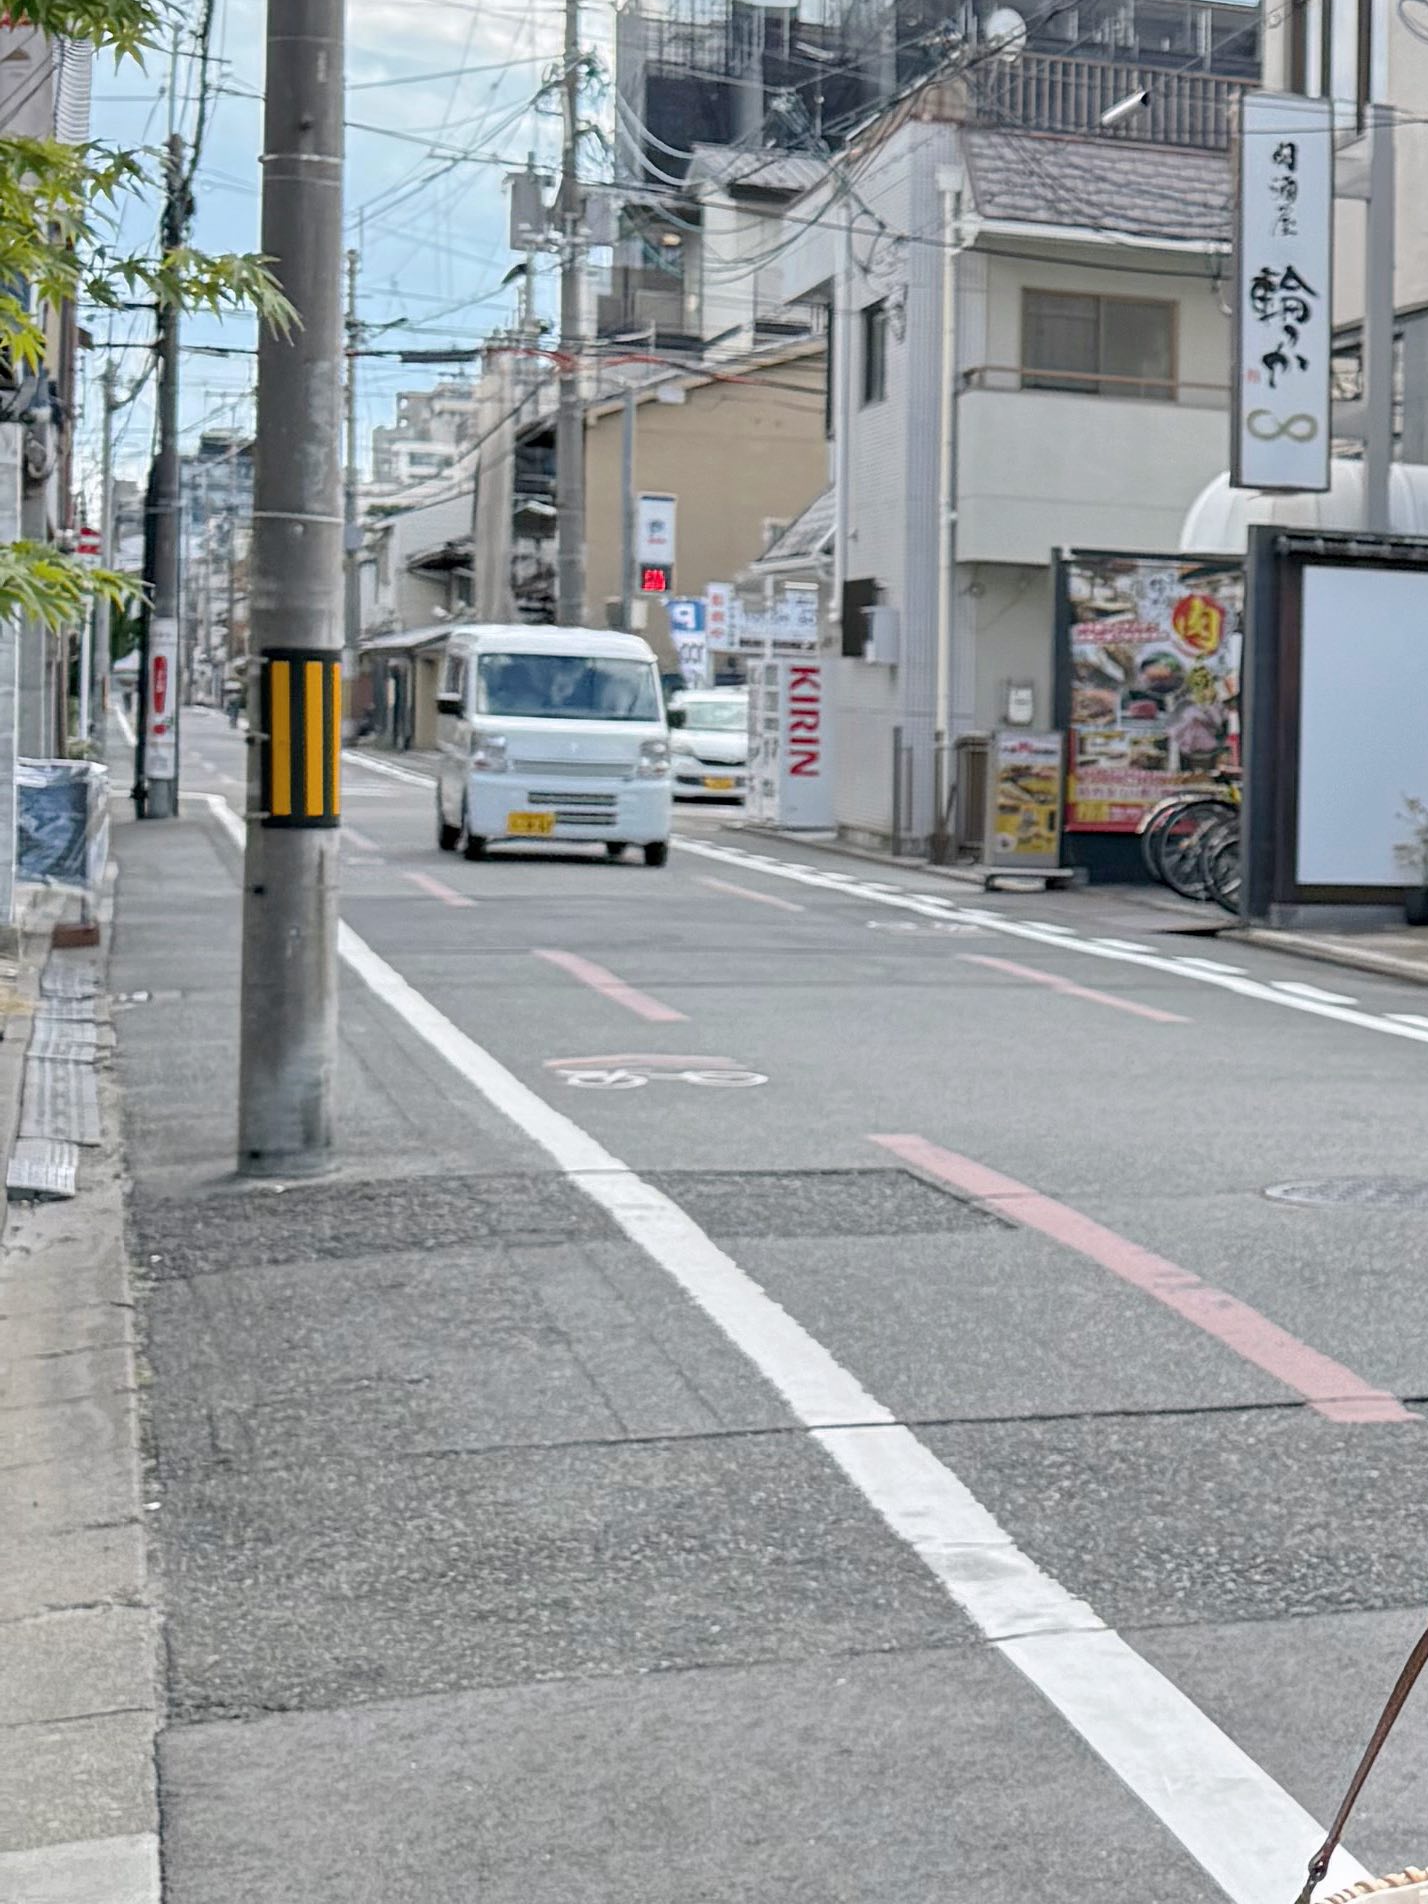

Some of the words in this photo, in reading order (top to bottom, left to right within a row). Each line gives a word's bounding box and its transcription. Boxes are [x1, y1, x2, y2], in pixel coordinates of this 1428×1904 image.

[1269, 142, 1298, 237] 肉酒屋
[789, 665, 821, 777] KIRIN
